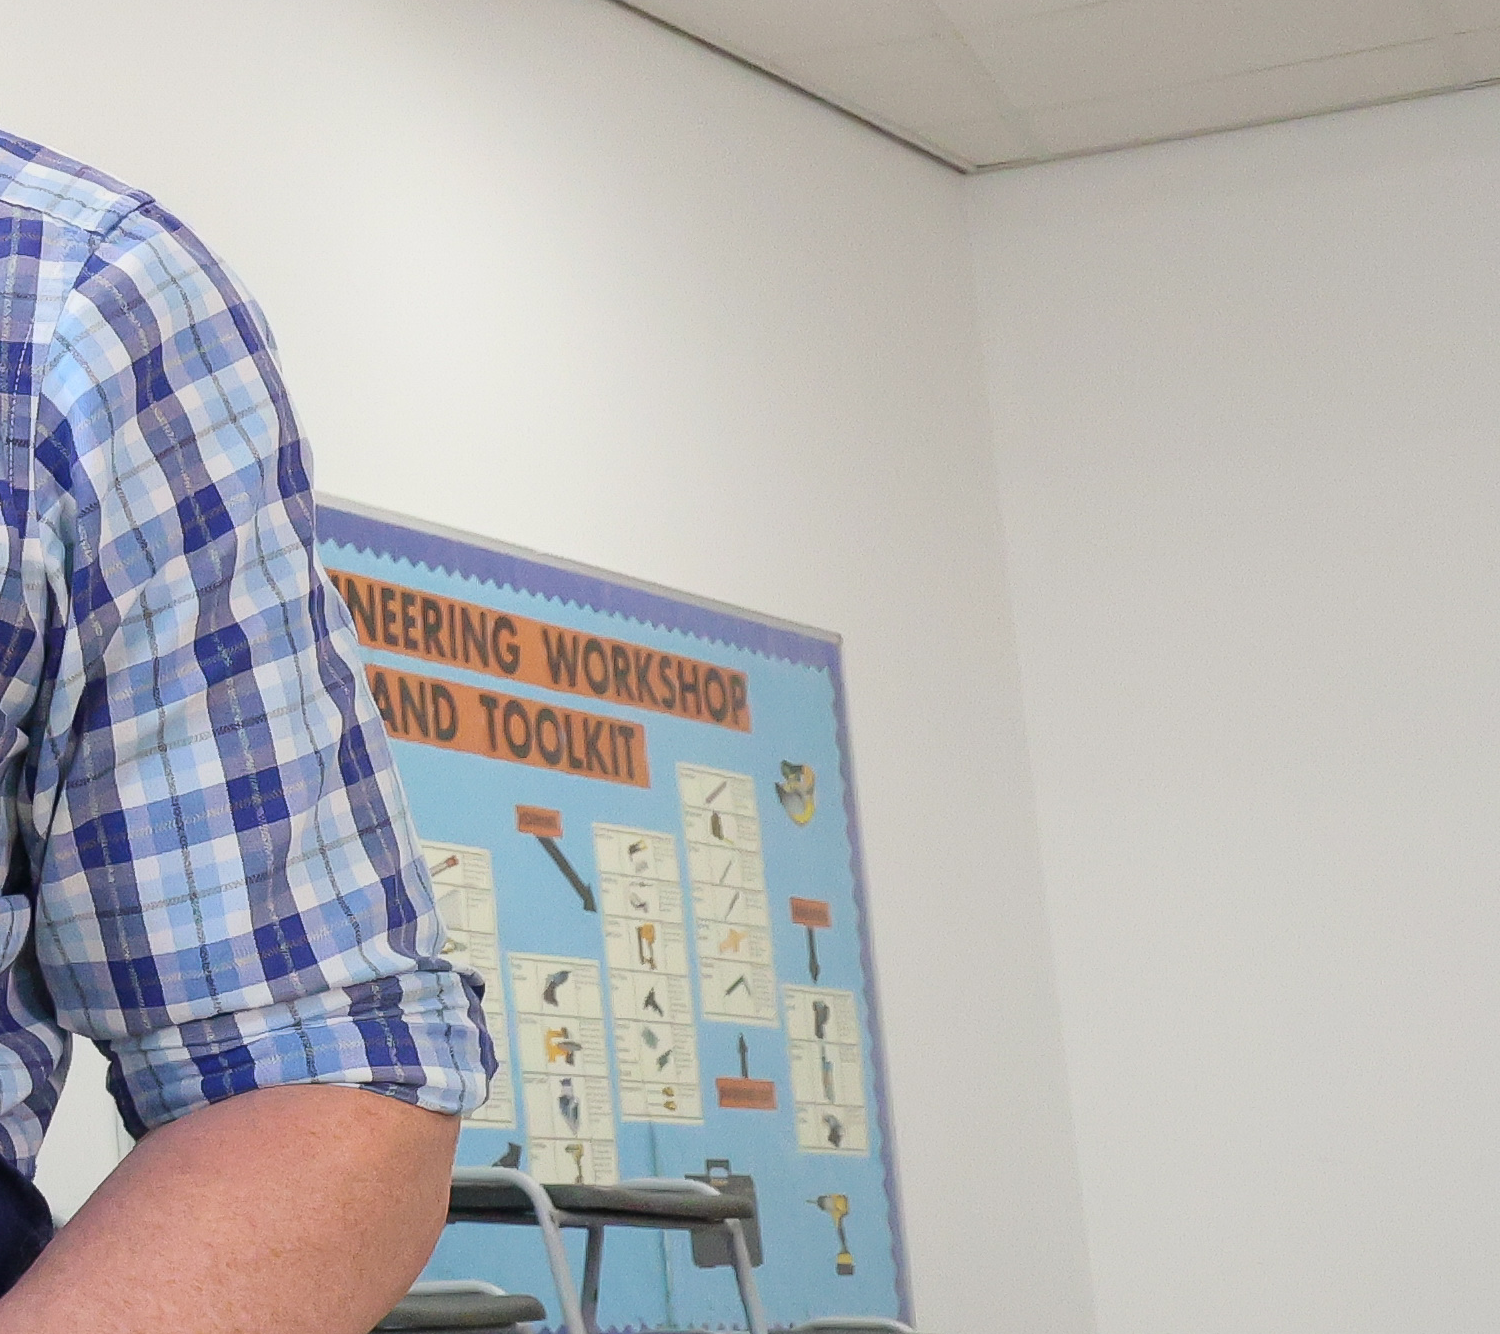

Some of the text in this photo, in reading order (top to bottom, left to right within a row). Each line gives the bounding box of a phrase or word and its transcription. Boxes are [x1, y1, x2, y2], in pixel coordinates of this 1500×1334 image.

[372, 671, 635, 781] AND TOOLKIT
[541, 627, 747, 723] WORKSHOP
